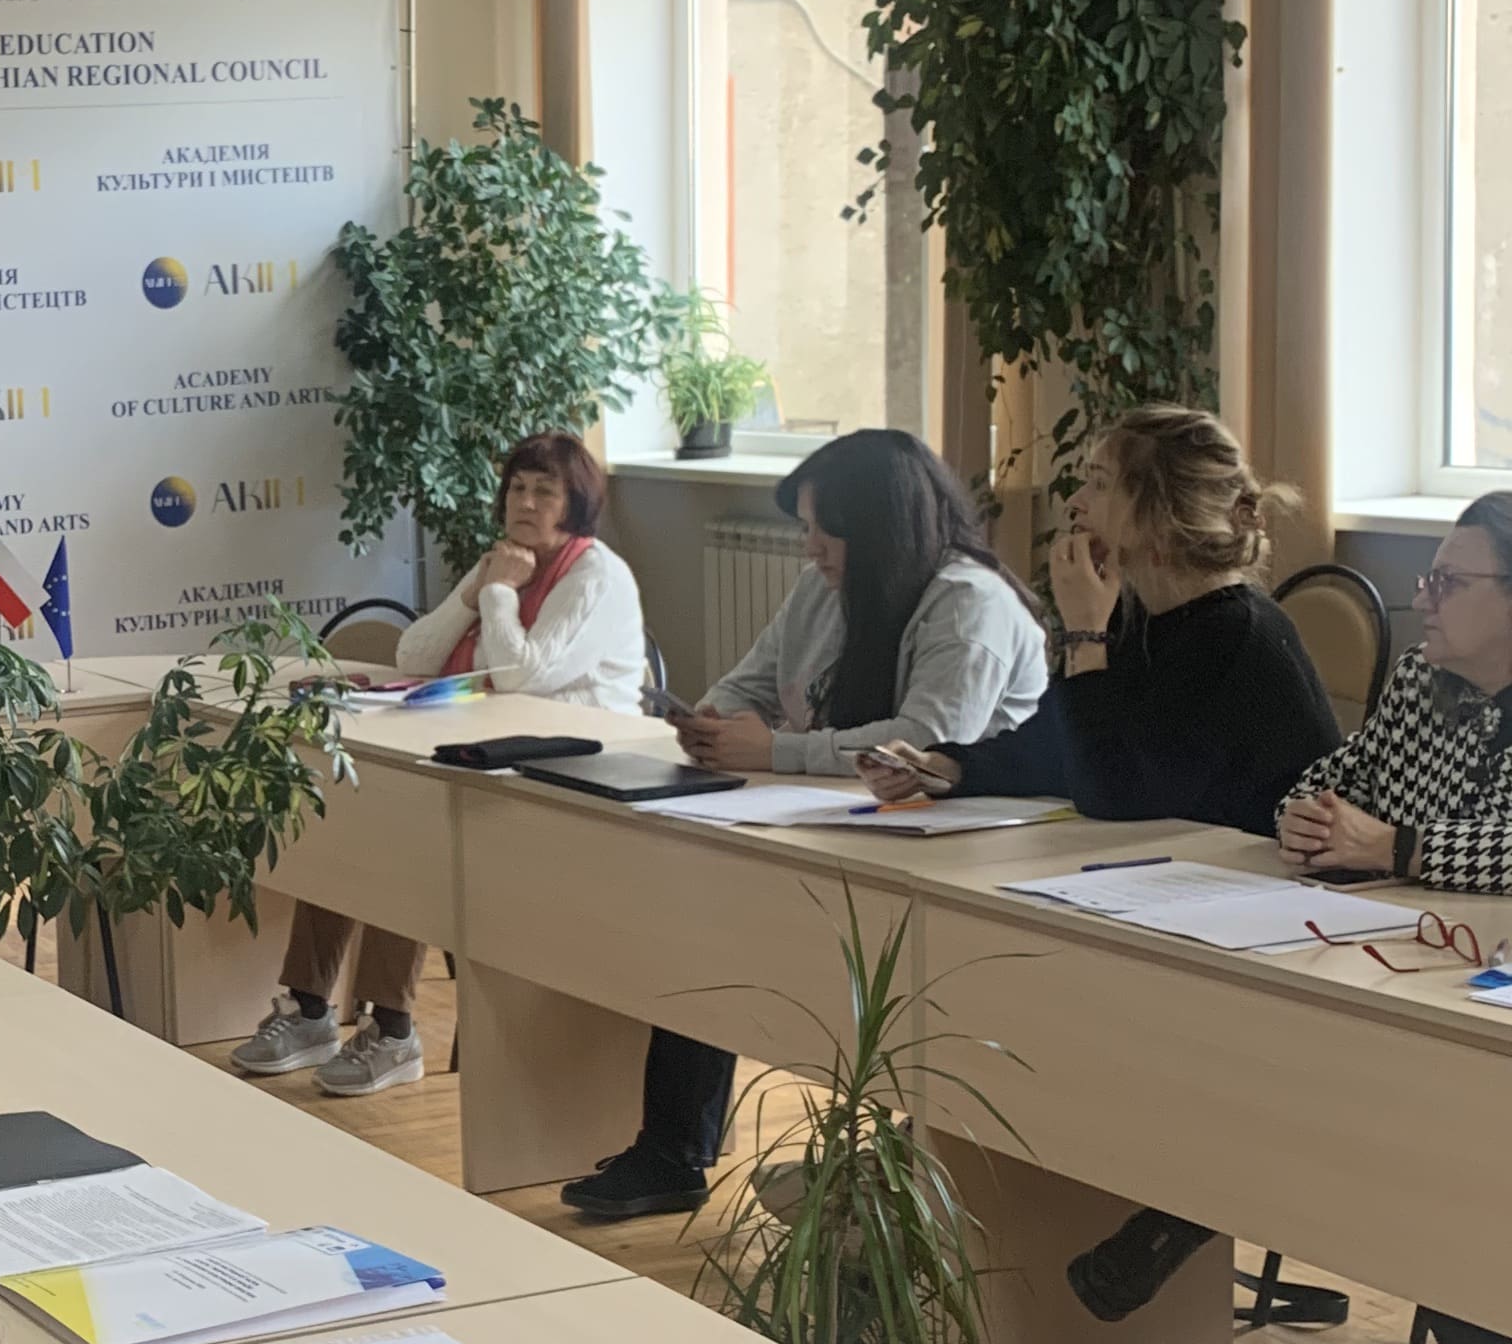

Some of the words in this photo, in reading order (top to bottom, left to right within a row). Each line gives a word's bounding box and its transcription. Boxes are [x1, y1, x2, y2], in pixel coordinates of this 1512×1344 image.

[0, 32, 154, 55] EDUCATION
[68, 64, 205, 87] REGIONAL
[211, 58, 327, 83] COUNCIL
[162, 144, 269, 164] АКАДЕМІЯ
[97, 171, 203, 191] КУЛЬТУРИ
[210, 171, 215, 187] І
[222, 166, 334, 185] МИСТЕЦТВ
[174, 368, 271, 389] ACADEMY
[112, 400, 138, 417] OF
[143, 394, 235, 415] CULTURE
[240, 391, 280, 408] AND
[39, 513, 90, 532] ARTS
[179, 579, 284, 604] АКАДЕМІЯ
[115, 609, 219, 634] КУЛЬТУРИ
